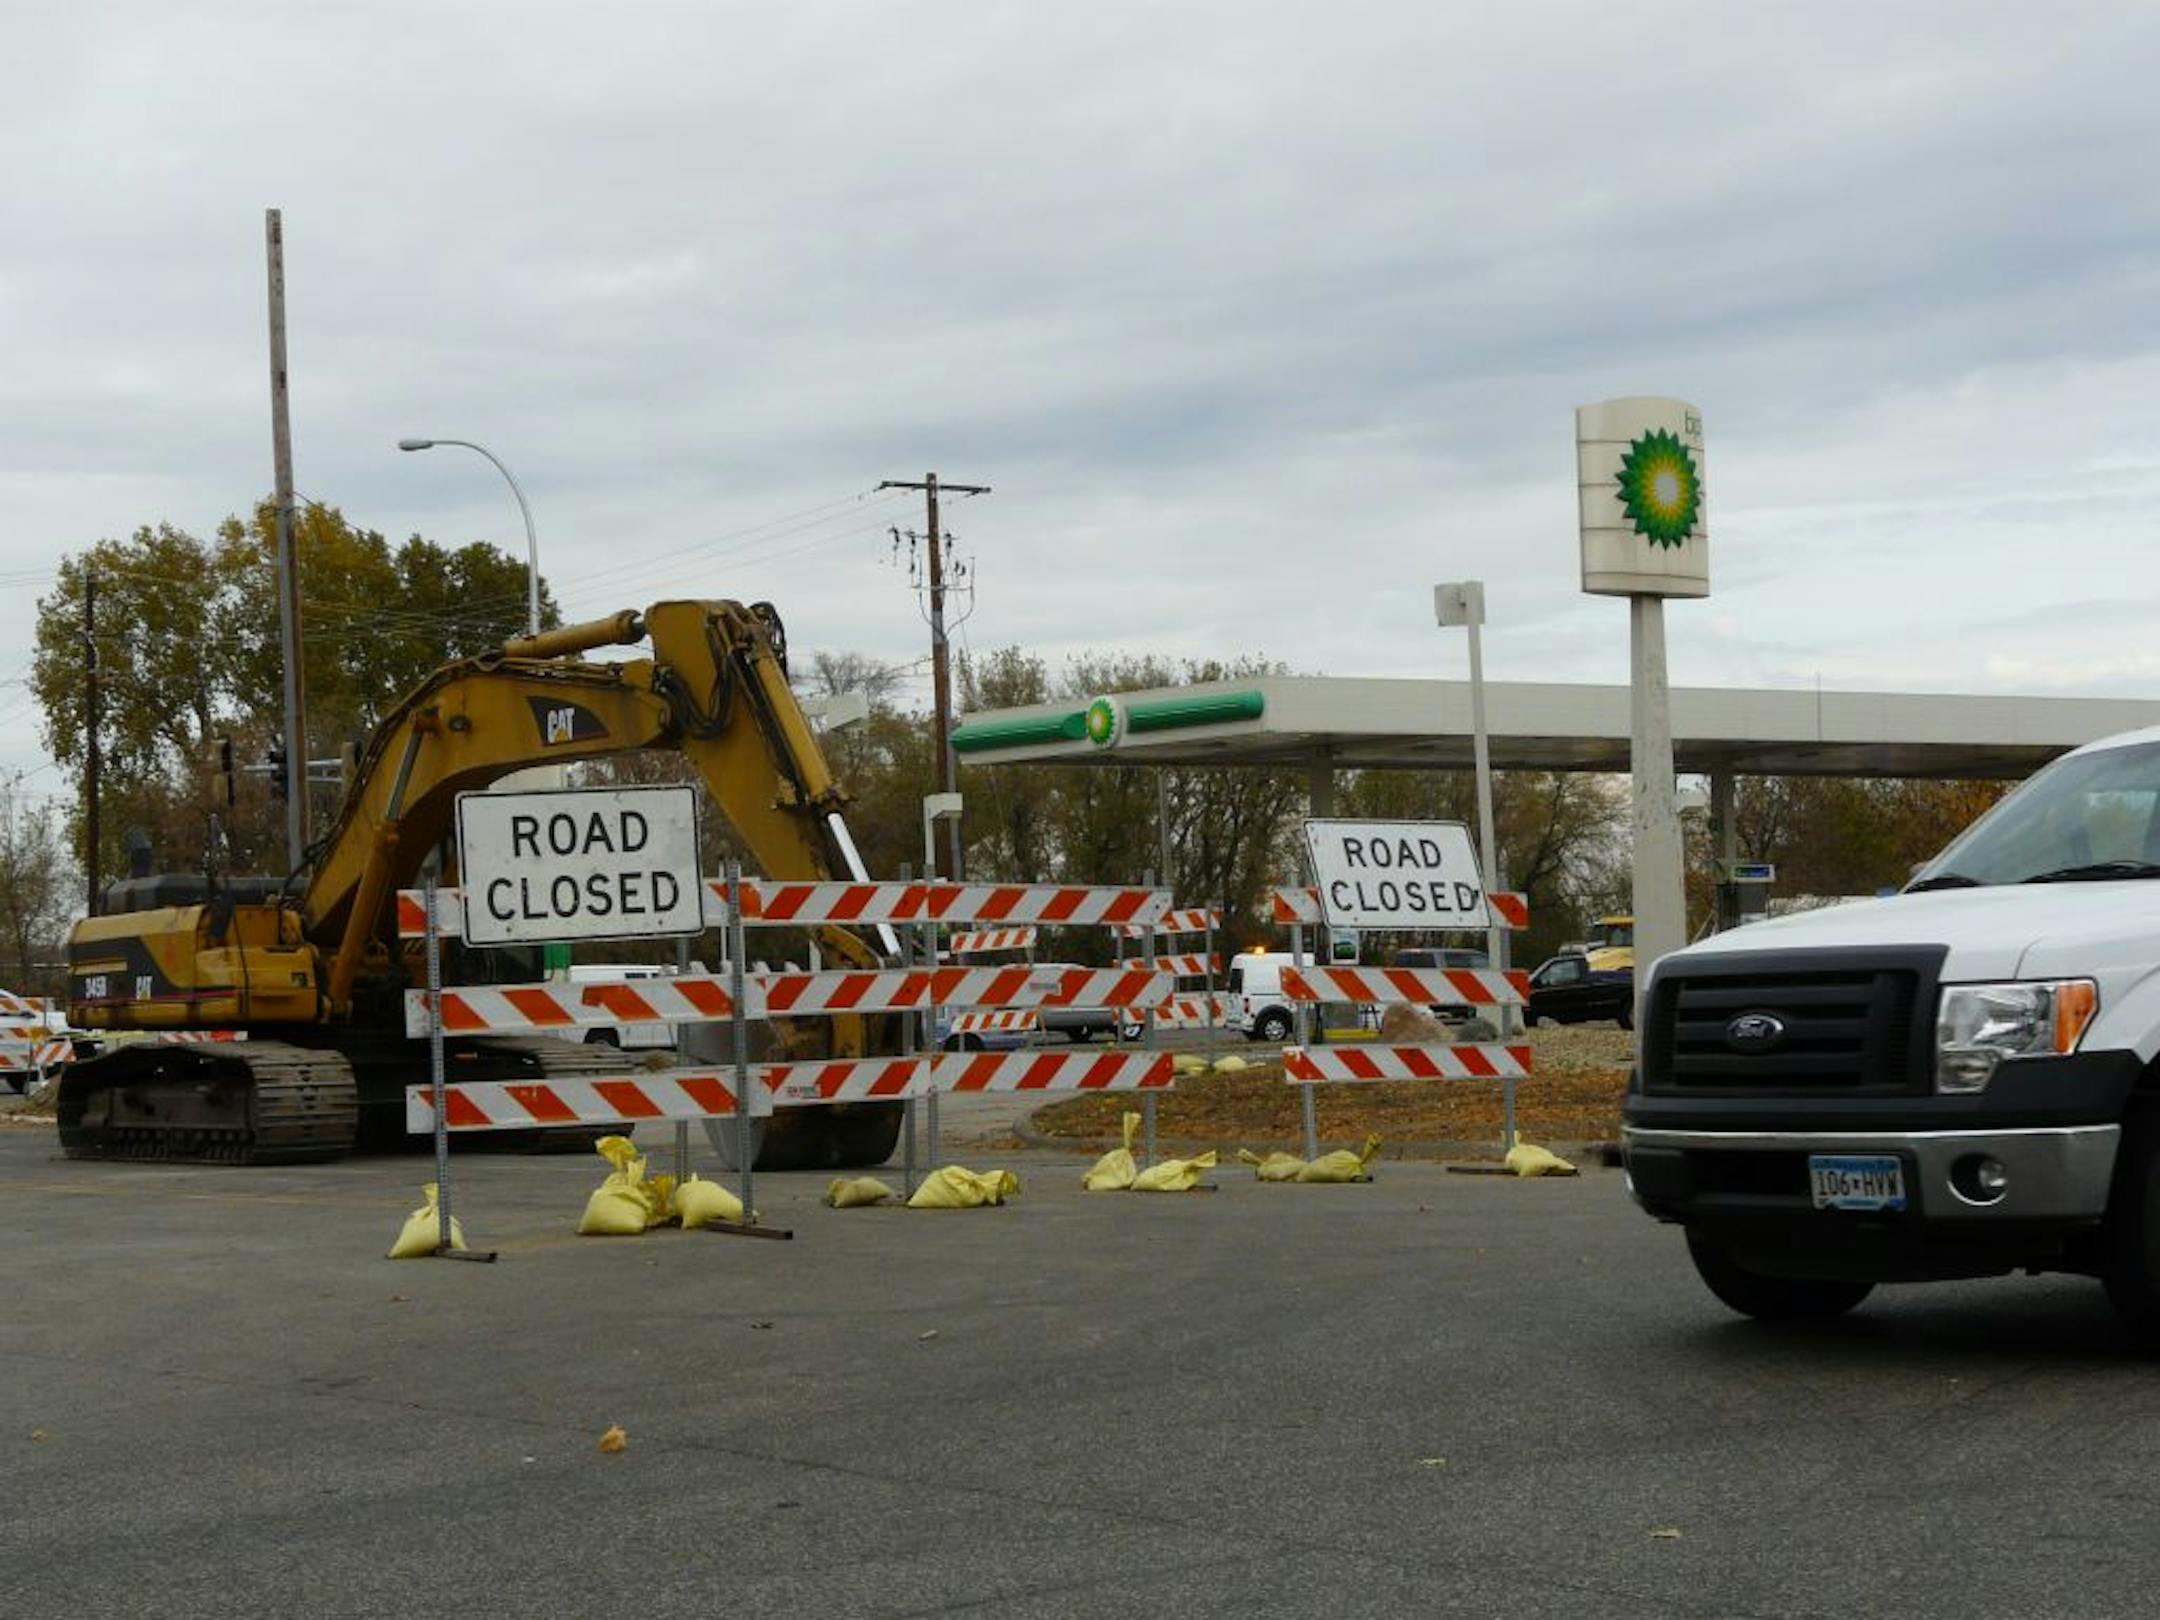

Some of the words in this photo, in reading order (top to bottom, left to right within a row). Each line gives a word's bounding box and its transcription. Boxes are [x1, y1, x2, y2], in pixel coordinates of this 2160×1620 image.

[547, 708, 575, 744] CAT
[511, 810, 649, 858] ROAD
[1342, 837, 1442, 869] ROAD
[486, 870, 680, 921] CLOSED
[1331, 880, 1478, 912] CLOSED
